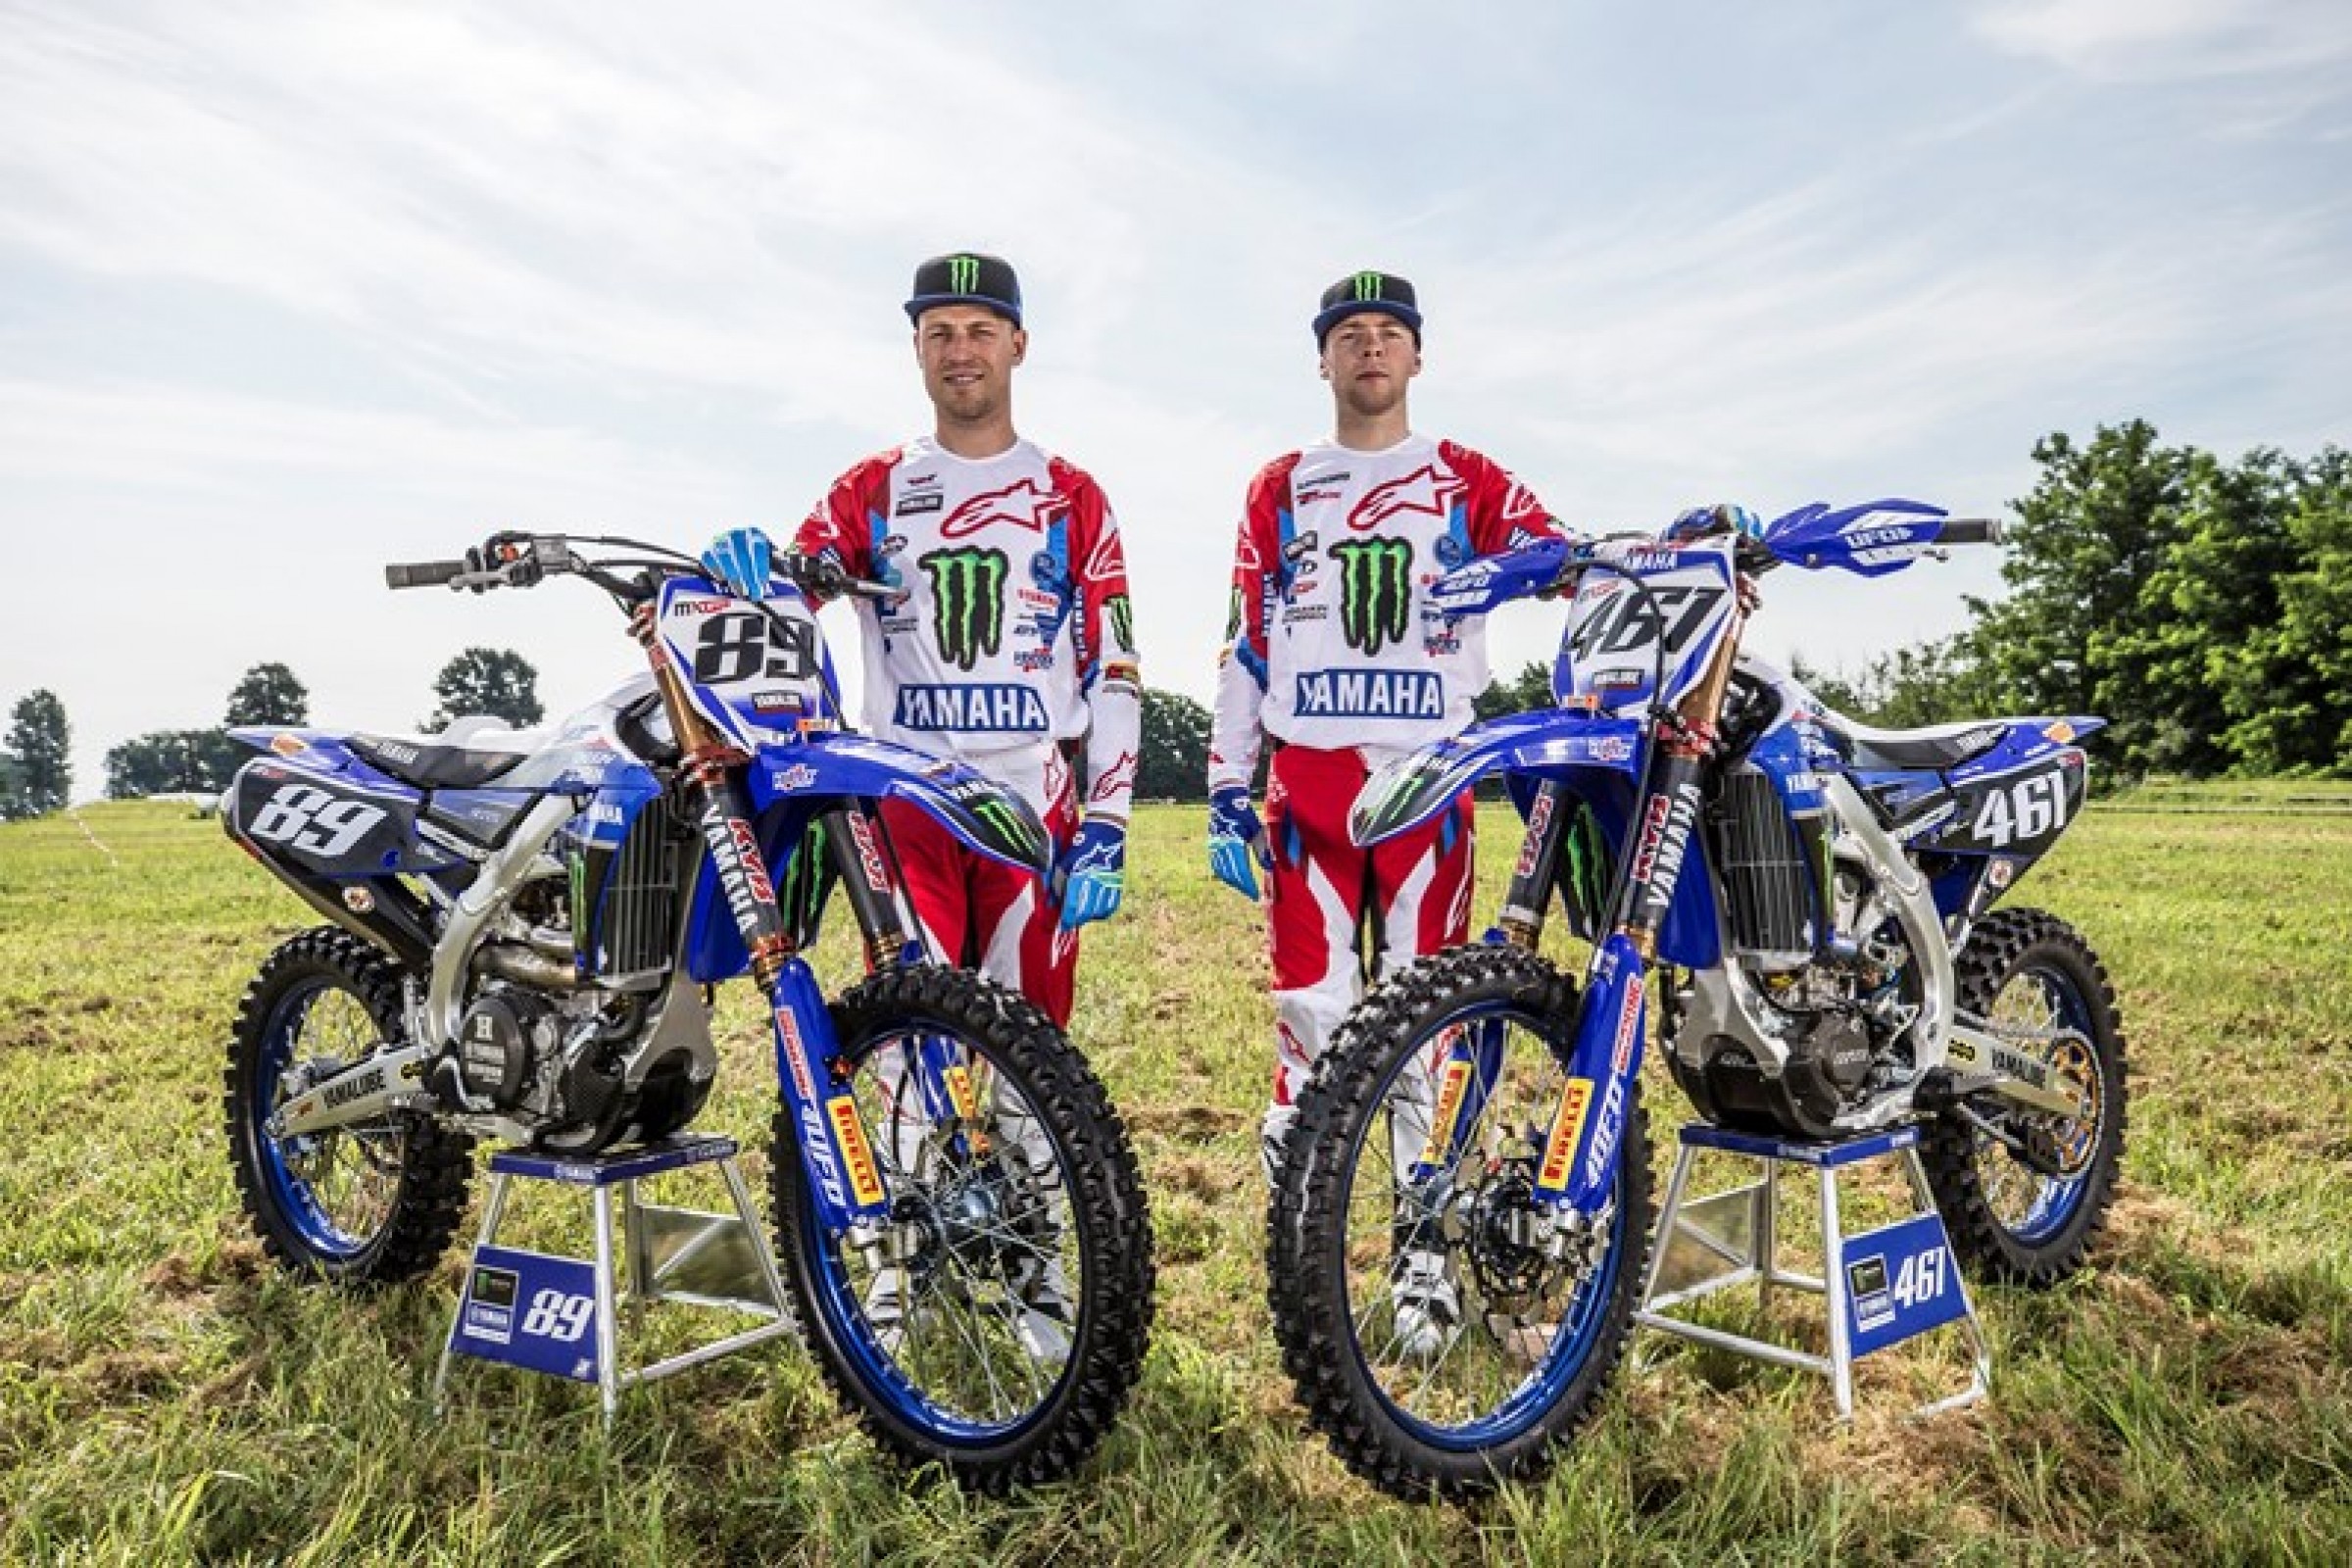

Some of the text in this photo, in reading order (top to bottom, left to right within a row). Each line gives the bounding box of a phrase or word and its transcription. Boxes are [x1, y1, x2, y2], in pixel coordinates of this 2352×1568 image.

[696, 613, 816, 685] 89
[1570, 586, 1727, 662] 461
[901, 689, 1046, 728] YAMAHA
[1299, 672, 1441, 714] YAMAHA
[250, 784, 387, 857] 89
[1646, 783, 1701, 907] YAMAHA
[1972, 770, 2066, 847] 461
[702, 802, 759, 934] YAMAHA
[836, 1104, 879, 1195] PIRELLI
[1544, 1087, 1584, 1180] PIRELLI
[1893, 1246, 1946, 1309] 461
[521, 1288, 595, 1343] 89
